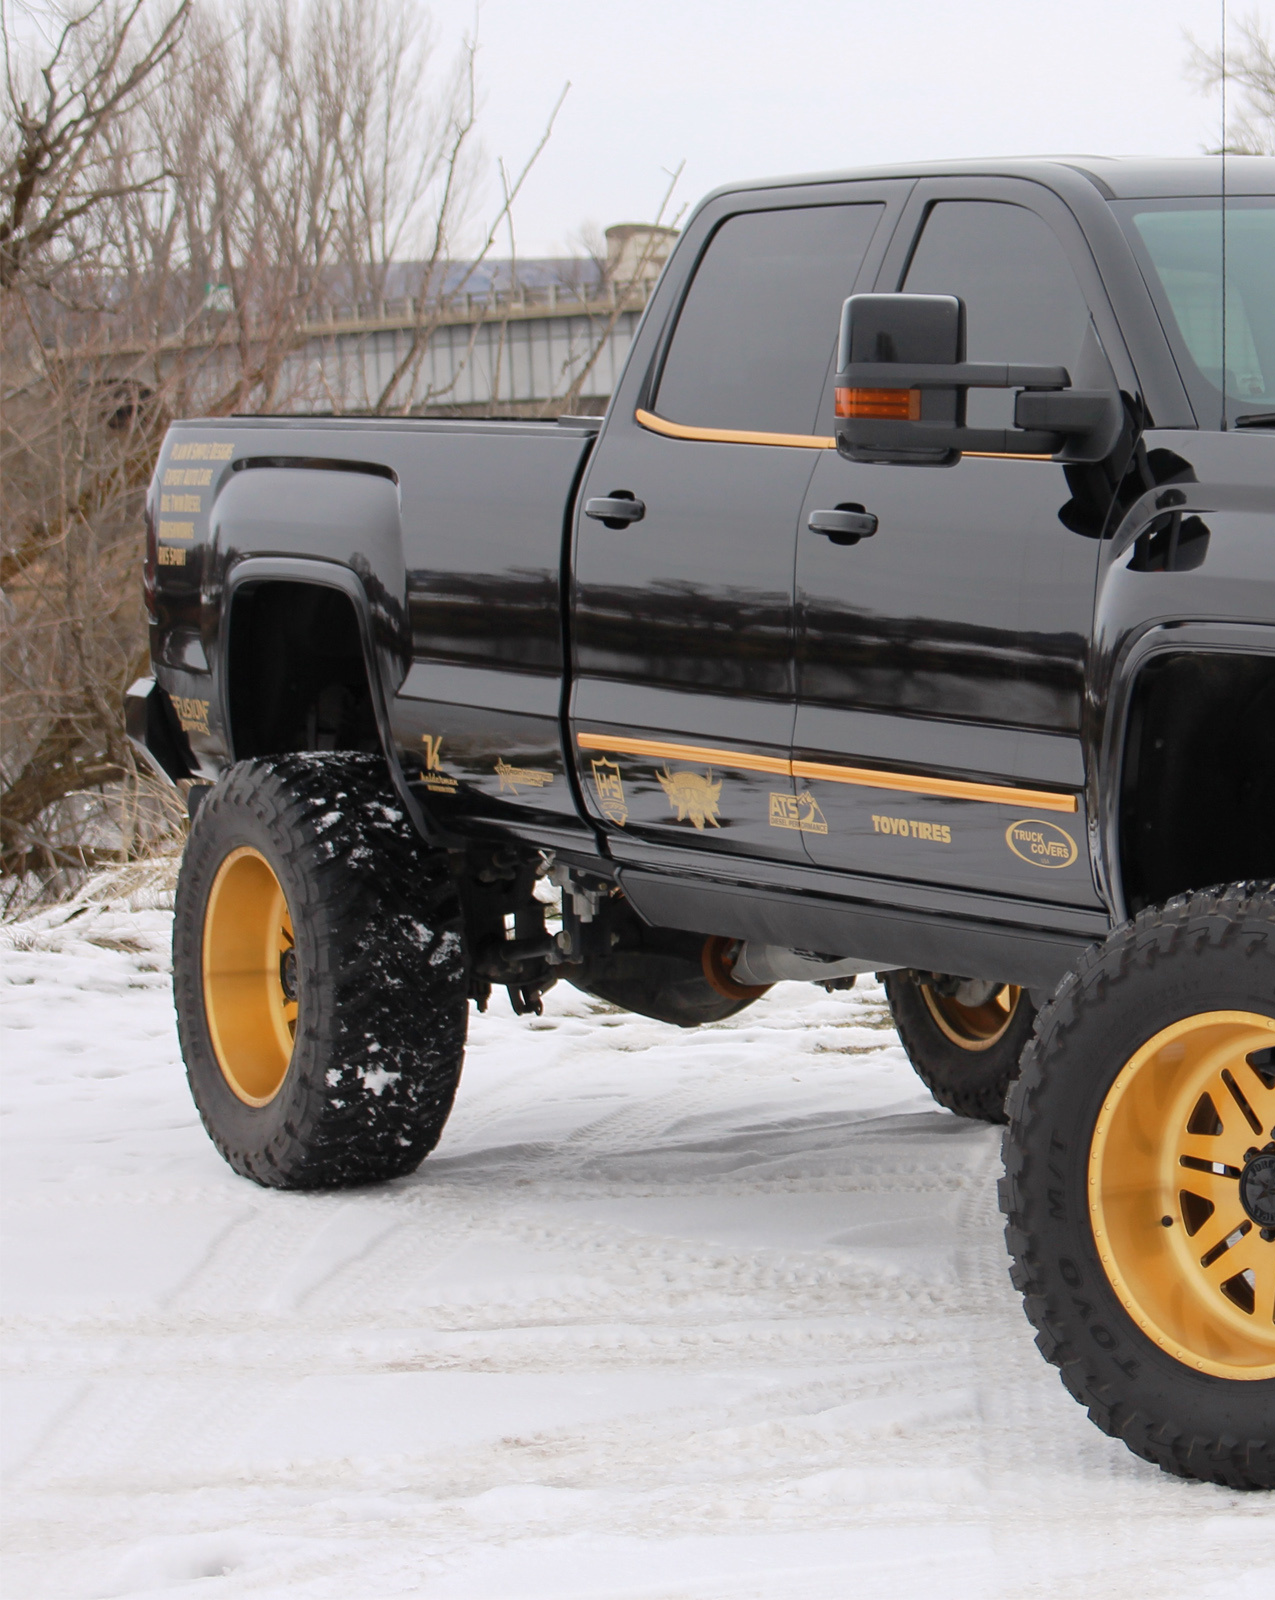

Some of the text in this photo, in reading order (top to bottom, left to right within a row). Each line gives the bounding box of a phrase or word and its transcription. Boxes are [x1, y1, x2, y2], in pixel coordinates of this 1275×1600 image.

[771, 796, 800, 819] ATS
[788, 820, 828, 833] PERORMANCE
[872, 814, 951, 844] TOYO TIRES
[1013, 829, 1043, 843] TRUCK
[1031, 839, 1069, 859] COVERS
